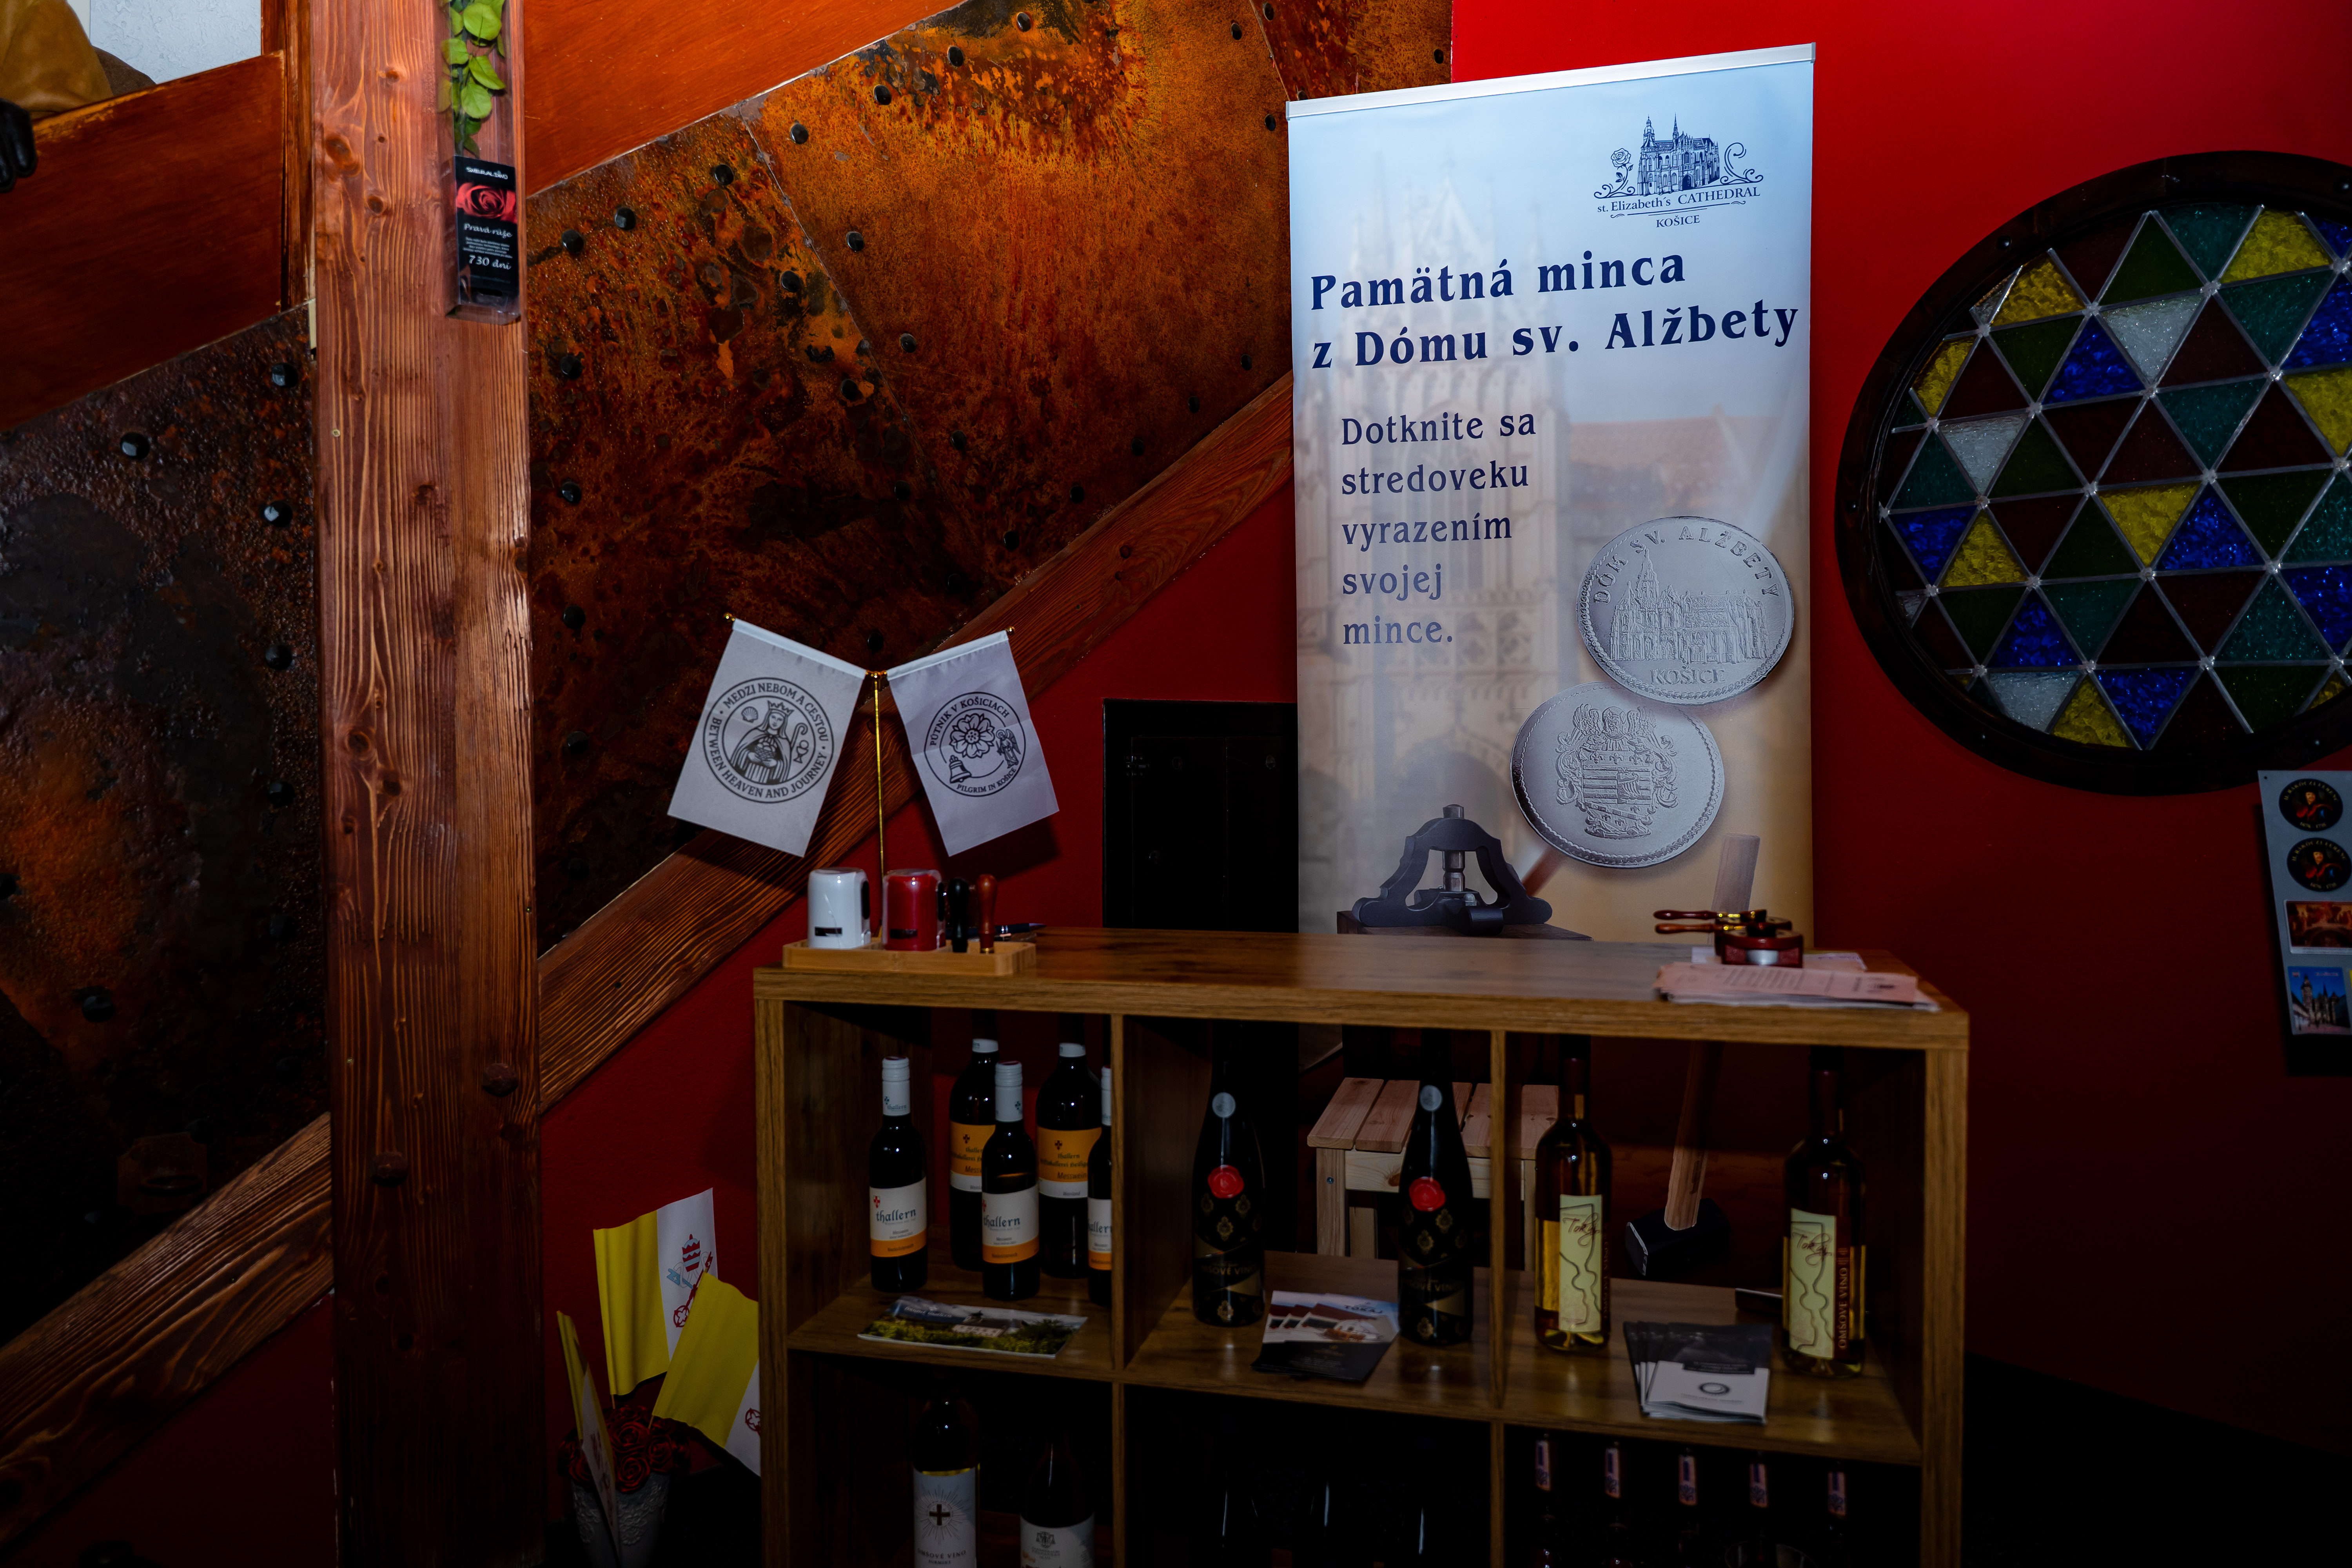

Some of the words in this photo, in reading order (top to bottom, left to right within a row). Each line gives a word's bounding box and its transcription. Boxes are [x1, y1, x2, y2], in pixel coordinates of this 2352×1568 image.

[466, 167, 508, 180] SMERALDINO
[1678, 187, 1760, 205] CATHEDRAL
[464, 222, 491, 234] Pravá
[1656, 215, 1700, 228] KOŠICE
[469, 254, 490, 266] 730
[1311, 258, 1514, 310] Pamätná
[1538, 250, 1685, 293] minca
[1313, 339, 1332, 369] z
[1355, 327, 1487, 367] Dómu
[1512, 323, 1579, 356] sv.
[1605, 299, 1798, 350] Alžbety
[1342, 412, 1484, 446] Dotknite
[1499, 410, 1536, 437] sa
[1342, 461, 1529, 495] stredoveku
[1342, 513, 1512, 552] vyrazením
[1593, 553, 1628, 604] DÓM
[1630, 530, 1666, 554] SV.
[1679, 526, 1779, 597] ALŽBETY
[1342, 564, 1443, 601] svojej
[1343, 615, 1454, 645] mince.
[1650, 663, 1726, 685] KOŠICE
[723, 684, 756, 709] MEDZI
[758, 682, 798, 700] NEBOM
[795, 695, 805, 705] A
[805, 702, 829, 742] CESTOU
[929, 710, 952, 746] PÚTNIK
[951, 704, 958, 713] V
[960, 695, 1010, 718] KOŠICIACH
[708, 716, 726, 771] BETWEEN
[722, 768, 763, 798] HEAVEN
[765, 788, 789, 799] AND
[791, 752, 828, 793] JOURNEY
[956, 783, 987, 793] PILGRIM
[988, 784, 997, 793] IN
[996, 767, 1017, 789] KOŠICE
[965, 1165, 982, 1173] Mess
[876, 1209, 916, 1223] thallern
[984, 1214, 1020, 1228] thallern
[1344, 1305, 1383, 1313] TOKAJ
